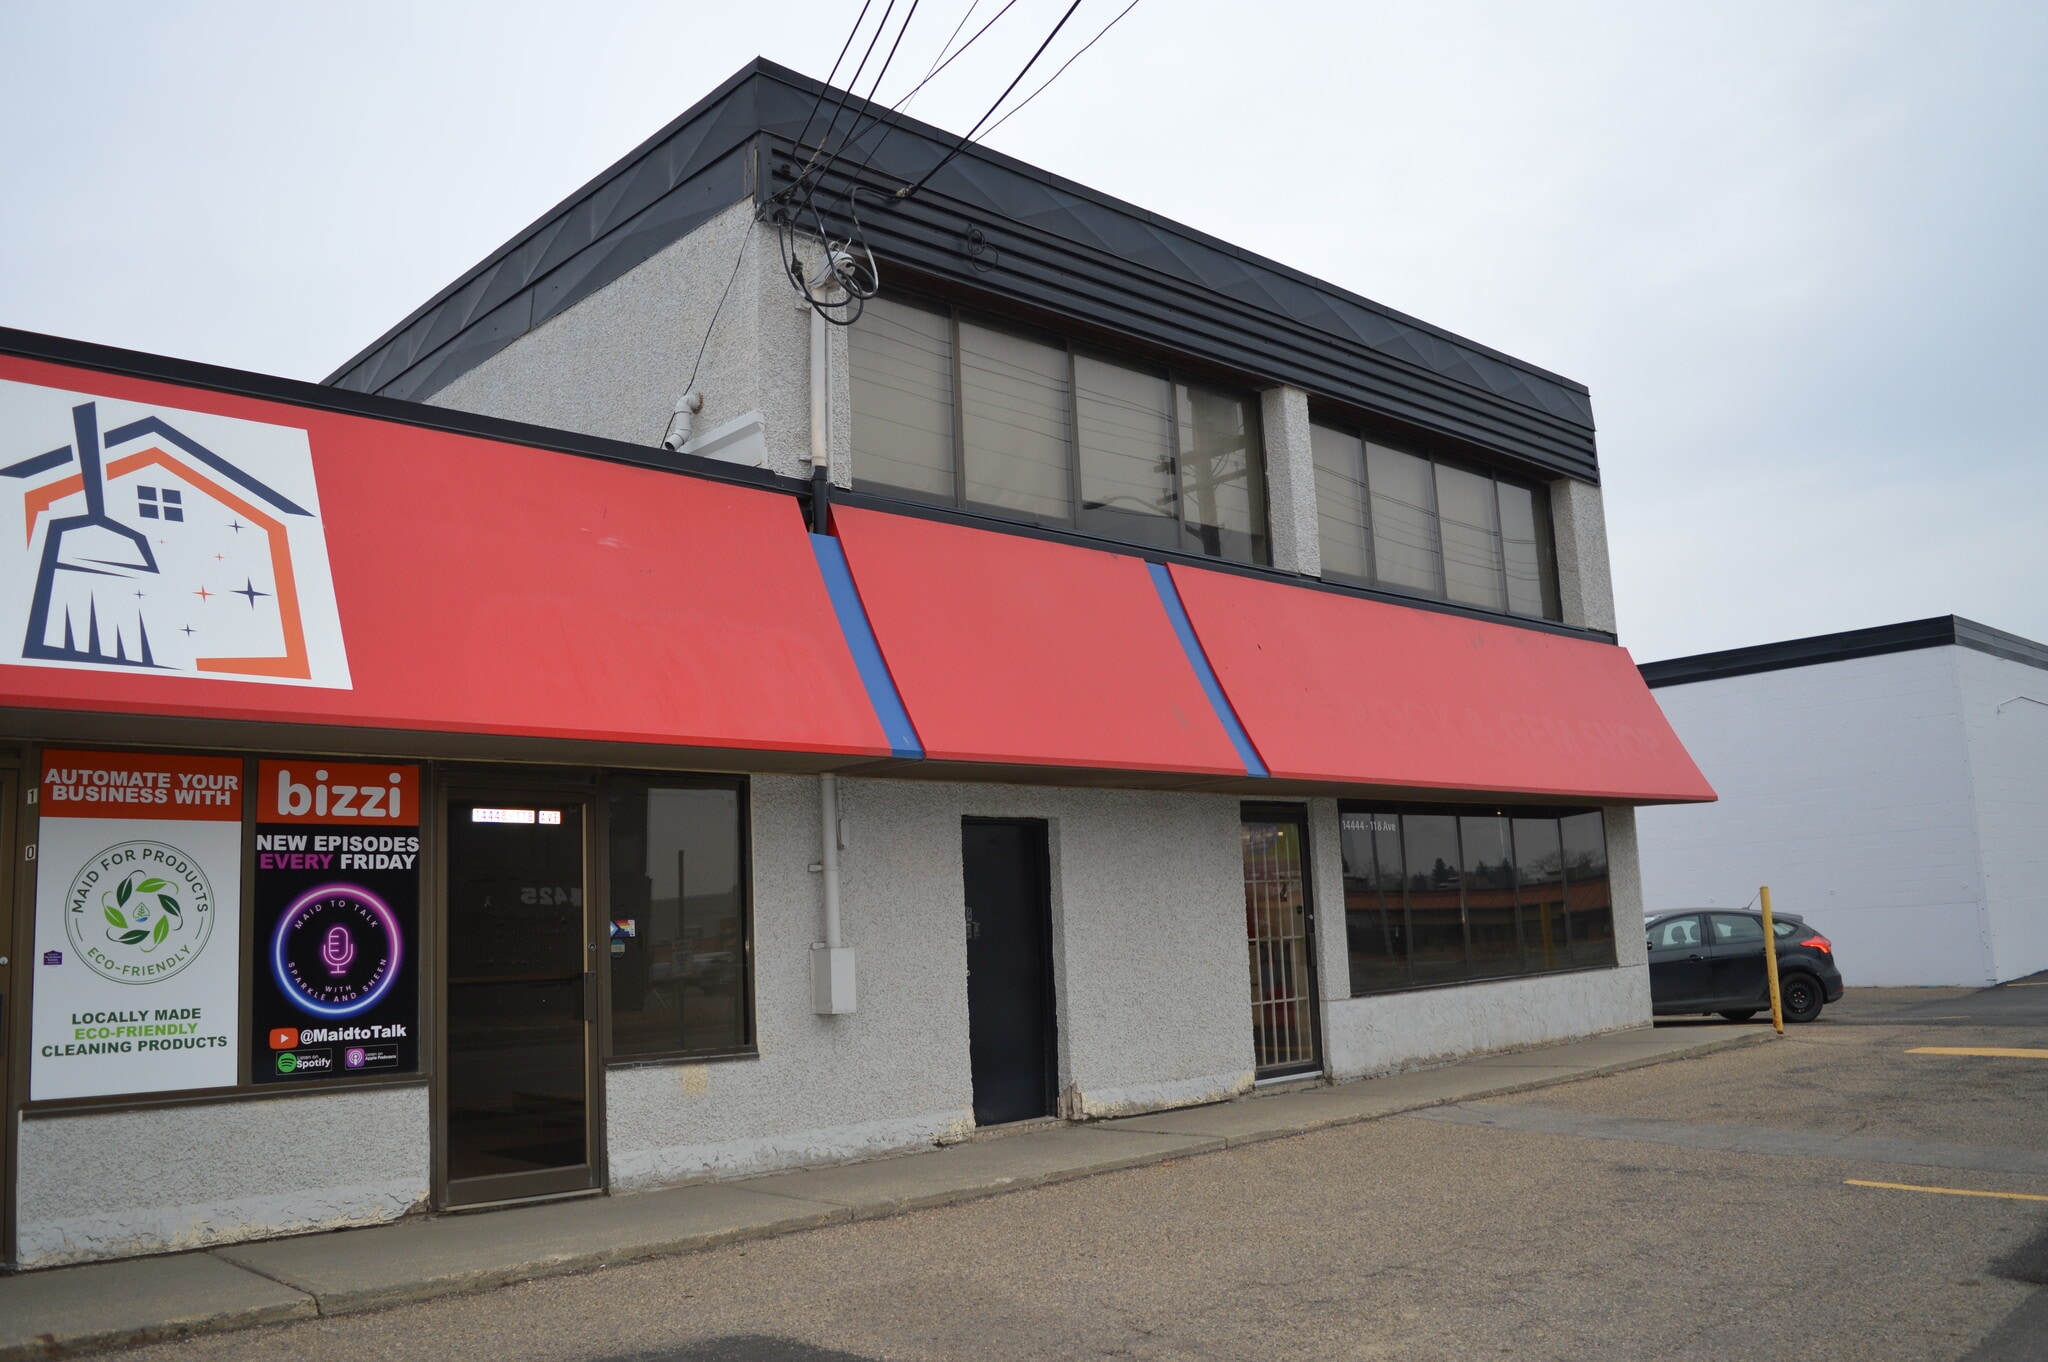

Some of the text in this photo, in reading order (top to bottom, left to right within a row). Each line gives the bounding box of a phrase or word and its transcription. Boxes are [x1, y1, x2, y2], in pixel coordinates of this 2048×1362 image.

[45, 768, 238, 790] AUTOMATE YOUR
[52, 785, 231, 806] BUSINESS WITH
[277, 769, 402, 818] bizzi
[1342, 820, 1365, 831] 14444
[1370, 820, 1382, 831] 118
[1383, 820, 1396, 831] Ave
[256, 834, 420, 852] NEW EPISODES
[260, 853, 417, 870] EVERY FRIDAY
[72, 848, 208, 913] MAID FOR PRODUCTS
[294, 900, 379, 929] MAID TO TALK
[87, 944, 191, 976] ECO-FRIENDLY
[288, 959, 387, 1003] SPARKLE AND SHEEN
[325, 985, 352, 993] WITH
[72, 1008, 201, 1025] LOCALLY MADE
[75, 1023, 198, 1040] ECO-FRIENDLY
[300, 1024, 407, 1045] @MaidtoTalk
[41, 1036, 227, 1057] CLEANING PRODUCTS
[296, 1057, 332, 1070] Spotify
